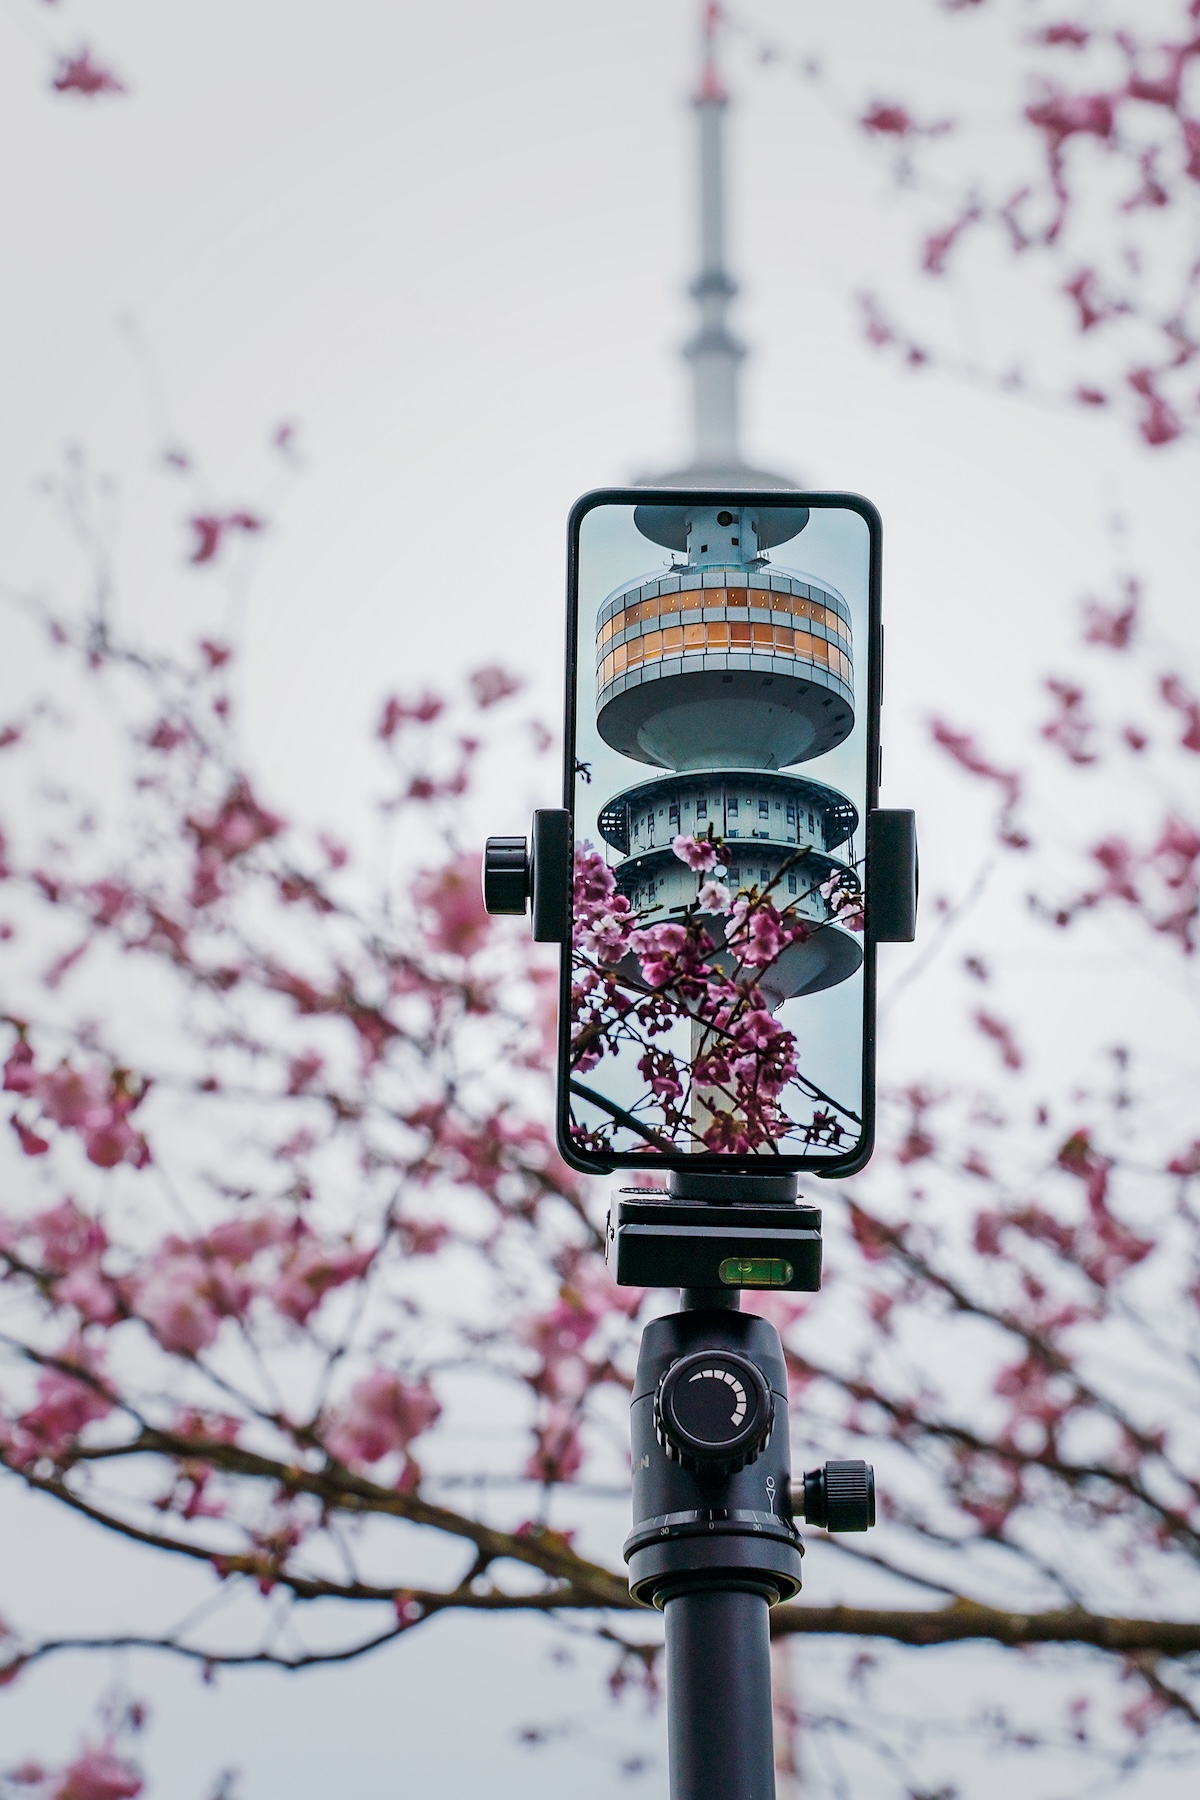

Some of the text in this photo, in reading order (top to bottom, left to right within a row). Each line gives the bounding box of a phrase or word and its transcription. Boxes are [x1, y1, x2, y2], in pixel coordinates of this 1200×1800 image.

[660, 1526, 670, 1535] 30
[708, 1522, 715, 1530] 0
[752, 1523, 763, 1532] 30
